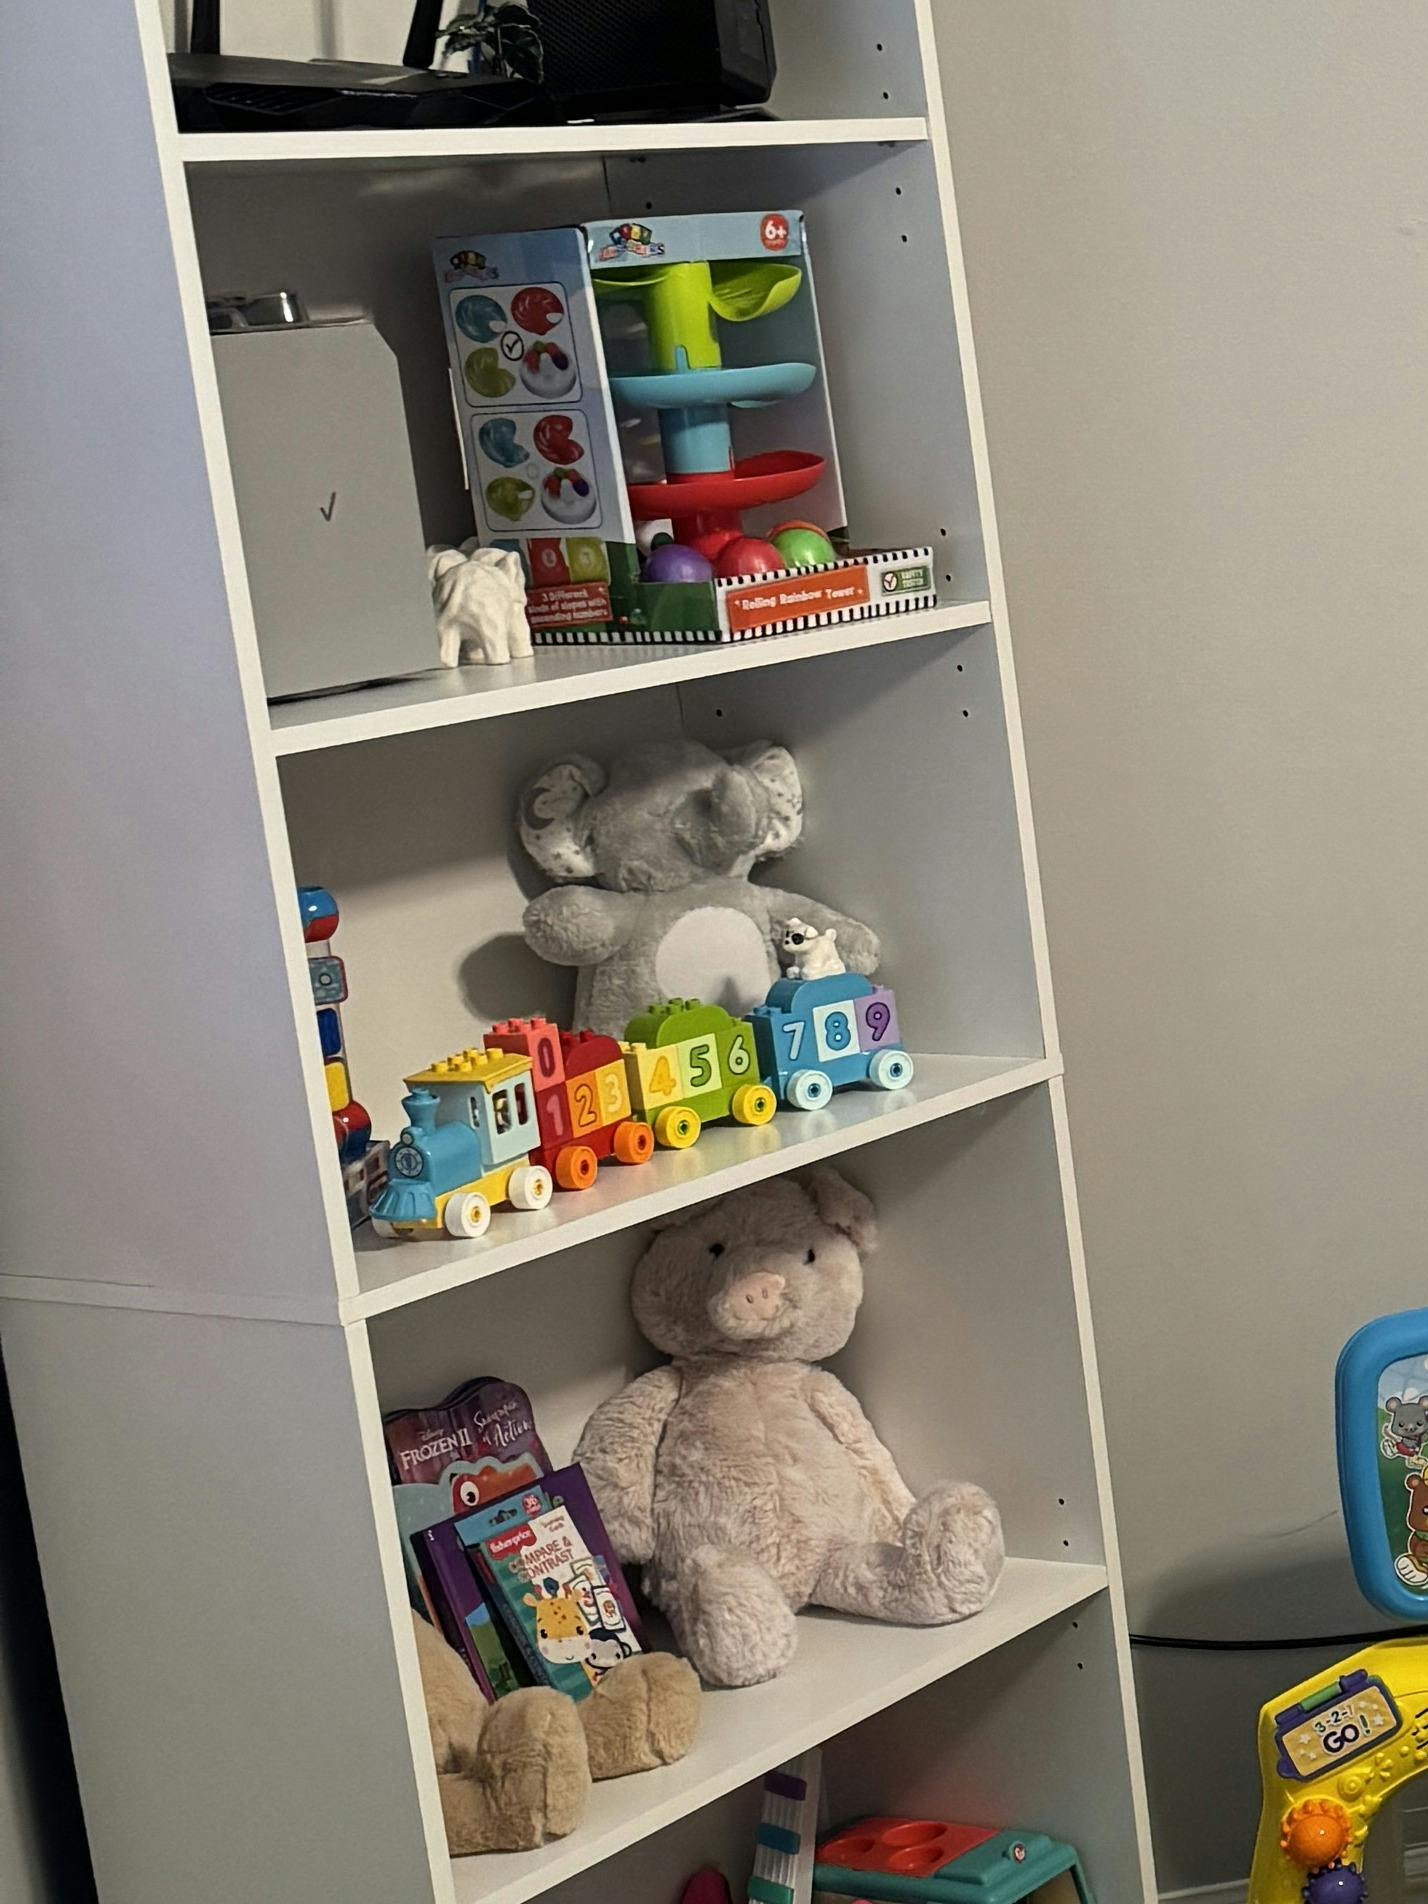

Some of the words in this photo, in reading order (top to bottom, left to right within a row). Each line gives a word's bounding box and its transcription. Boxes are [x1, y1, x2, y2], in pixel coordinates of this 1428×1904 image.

[765, 220, 787, 239] 6+
[742, 594, 777, 610] Rolling
[780, 590, 822, 605] Rainbow
[825, 587, 855, 599] Tower
[783, 1020, 807, 1062] 7
[824, 1010, 852, 1052] 8
[865, 1001, 892, 1043] 9
[537, 1036, 554, 1078] 0
[648, 1055, 678, 1097] 4
[689, 1043, 713, 1088] 5
[728, 1034, 751, 1076] 6
[572, 1082, 598, 1128] 2
[603, 1072, 622, 1115] 3
[400, 1433, 459, 1471] FROZEN
[518, 1548, 575, 1583] CONTRAST
